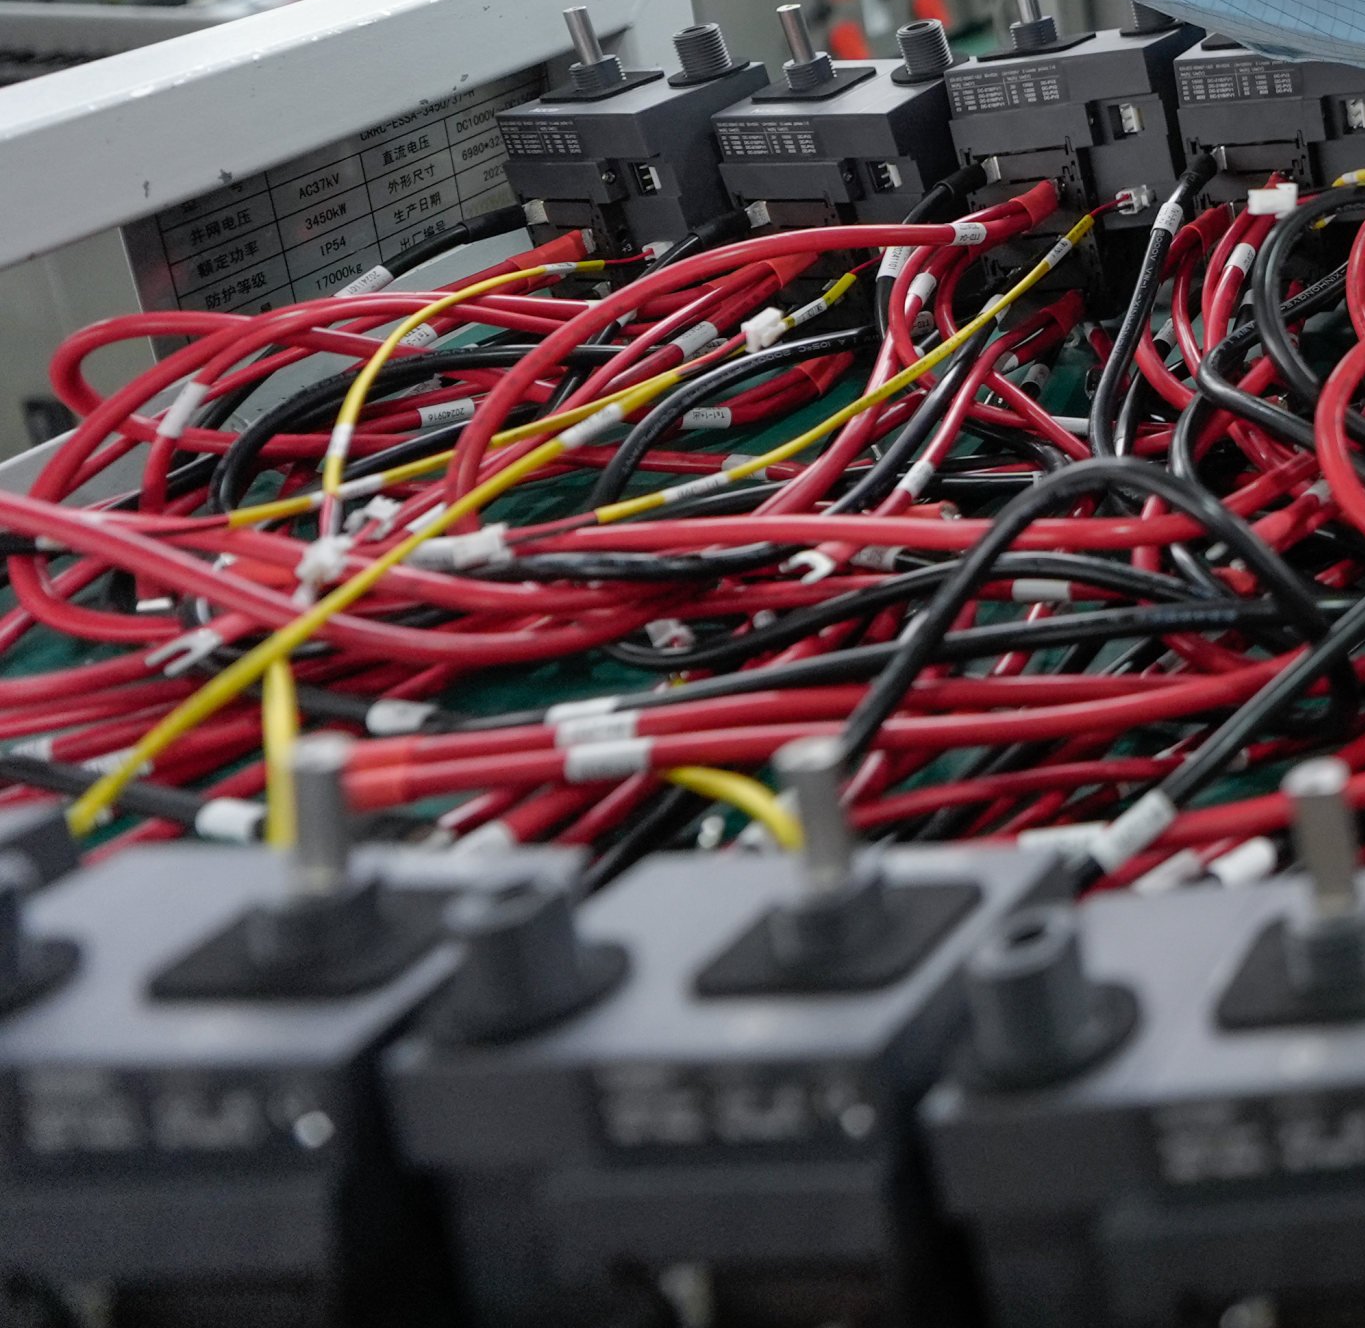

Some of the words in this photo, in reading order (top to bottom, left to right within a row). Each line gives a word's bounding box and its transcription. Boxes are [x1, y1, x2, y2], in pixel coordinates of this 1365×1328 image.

[382, 134, 431, 166] 直流电压
[299, 173, 340, 200] AC37kV
[388, 163, 435, 194] 外形尺寸
[305, 203, 347, 230] 3450kW
[394, 192, 441, 224] 生产日期
[197, 241, 259, 278] 额定功率
[320, 236, 346, 256] IP54
[205, 272, 267, 310] 防护等级
[316, 263, 363, 290] 17000kg
